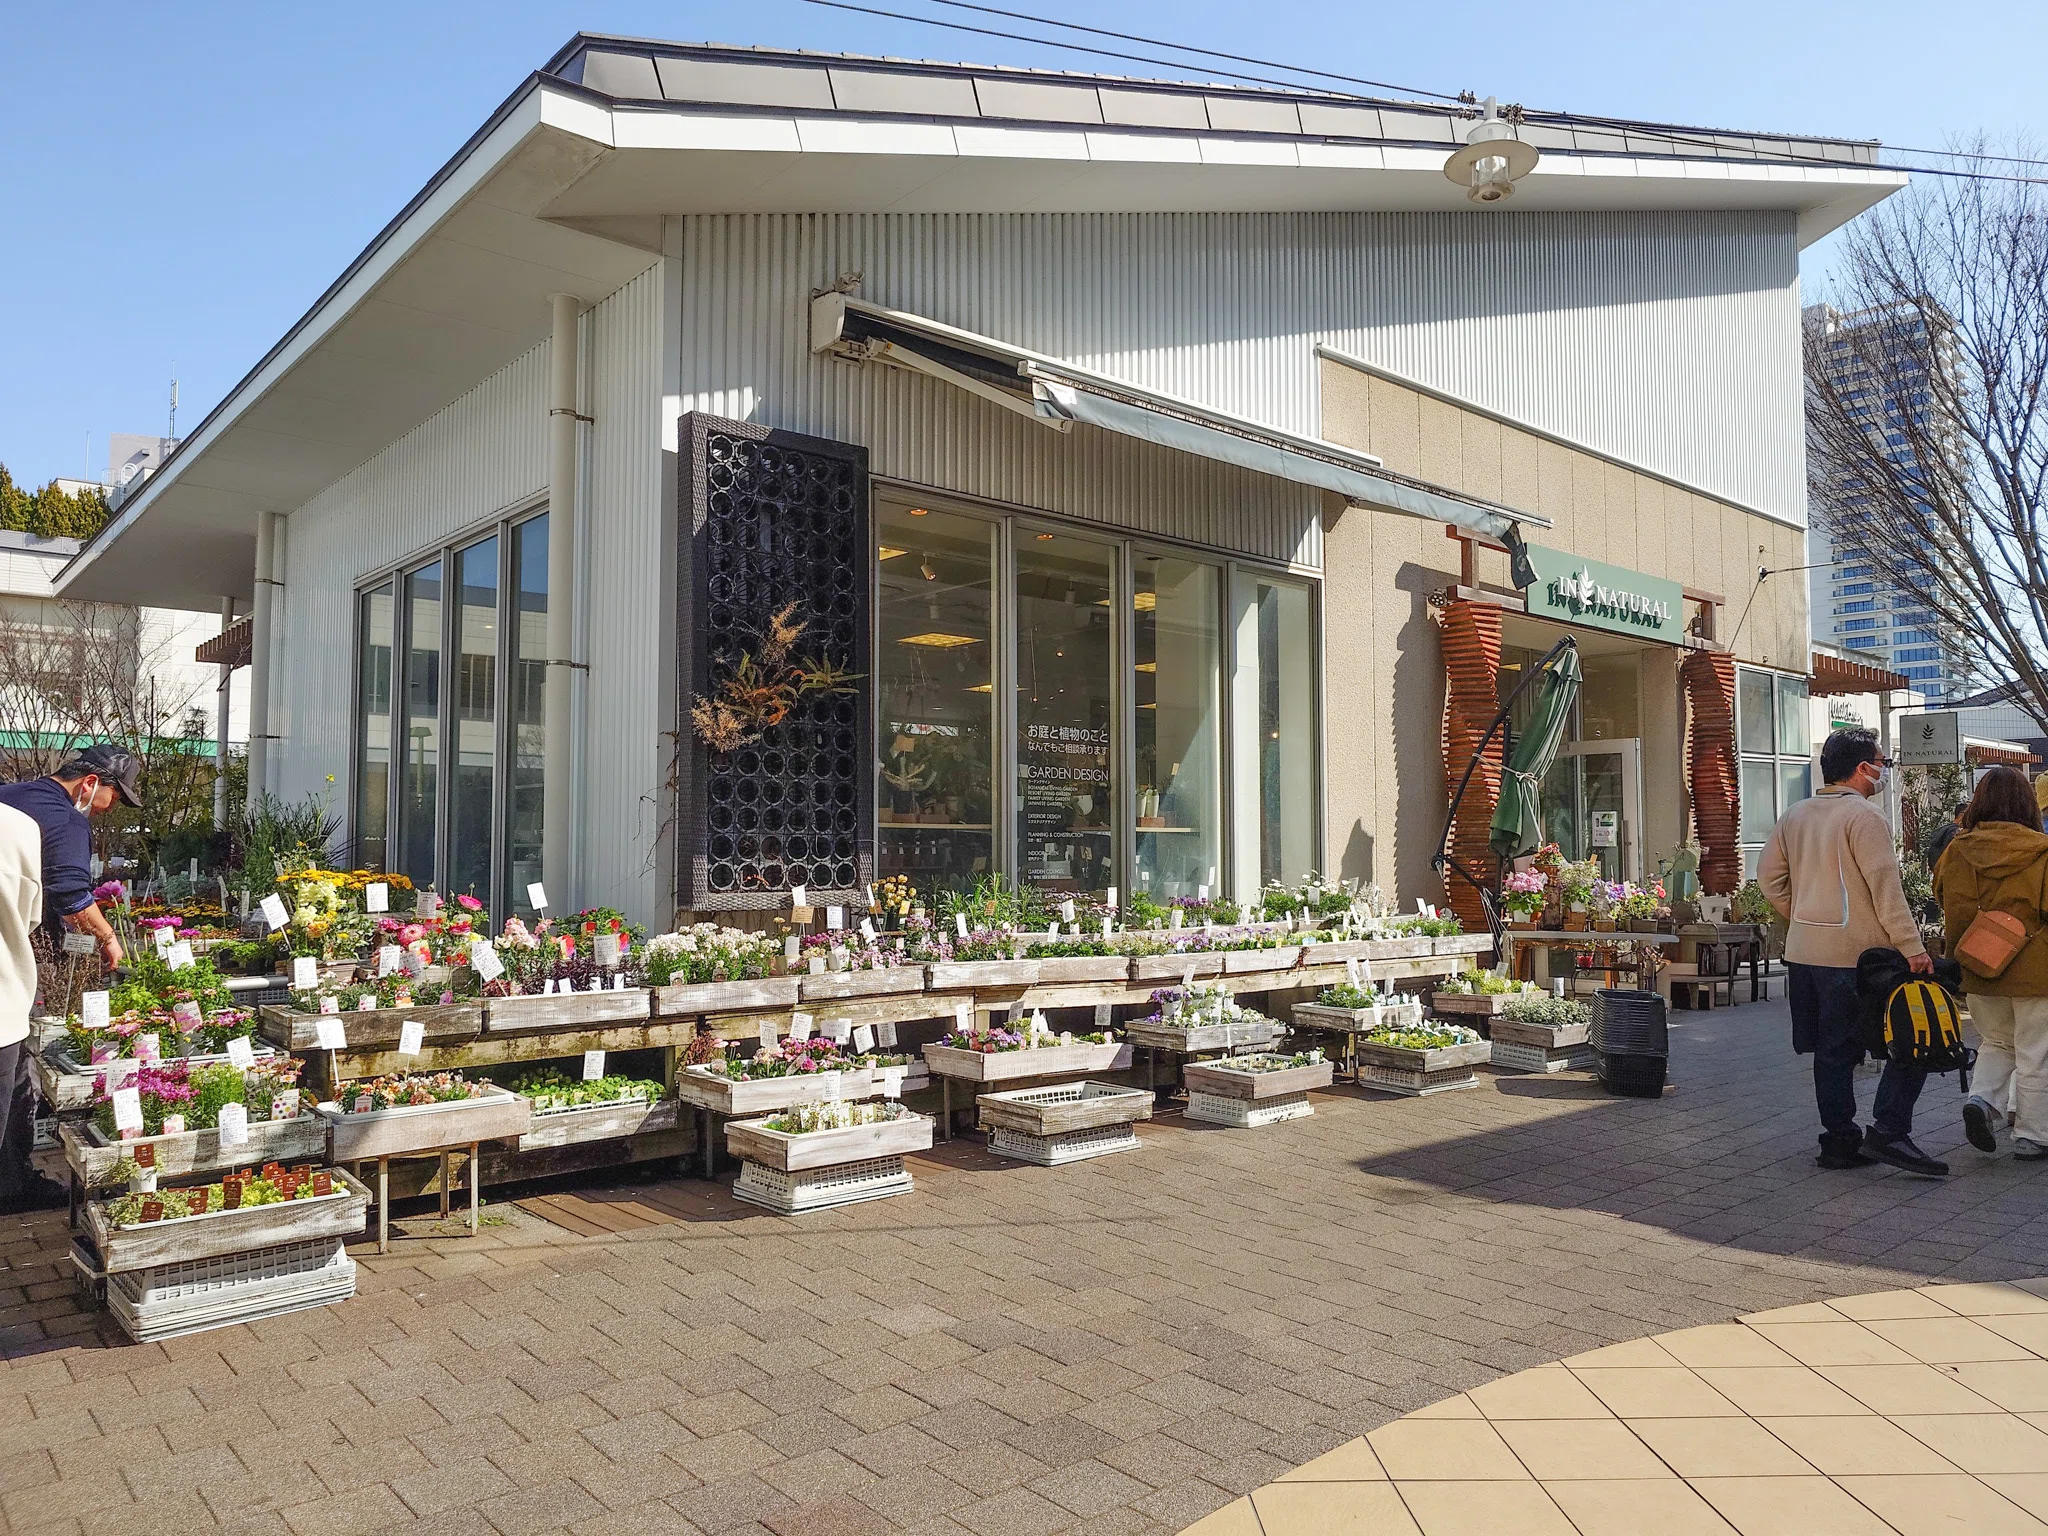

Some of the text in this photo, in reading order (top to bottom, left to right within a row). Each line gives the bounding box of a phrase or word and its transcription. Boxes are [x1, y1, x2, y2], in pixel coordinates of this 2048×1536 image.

[1557, 576, 1672, 620] IN NATURAL
[1027, 724, 1109, 743] お庭と植物のこと
[1027, 741, 1109, 756] なんでもご相談承ります
[1027, 765, 1109, 782] GARDEN DESIGN
